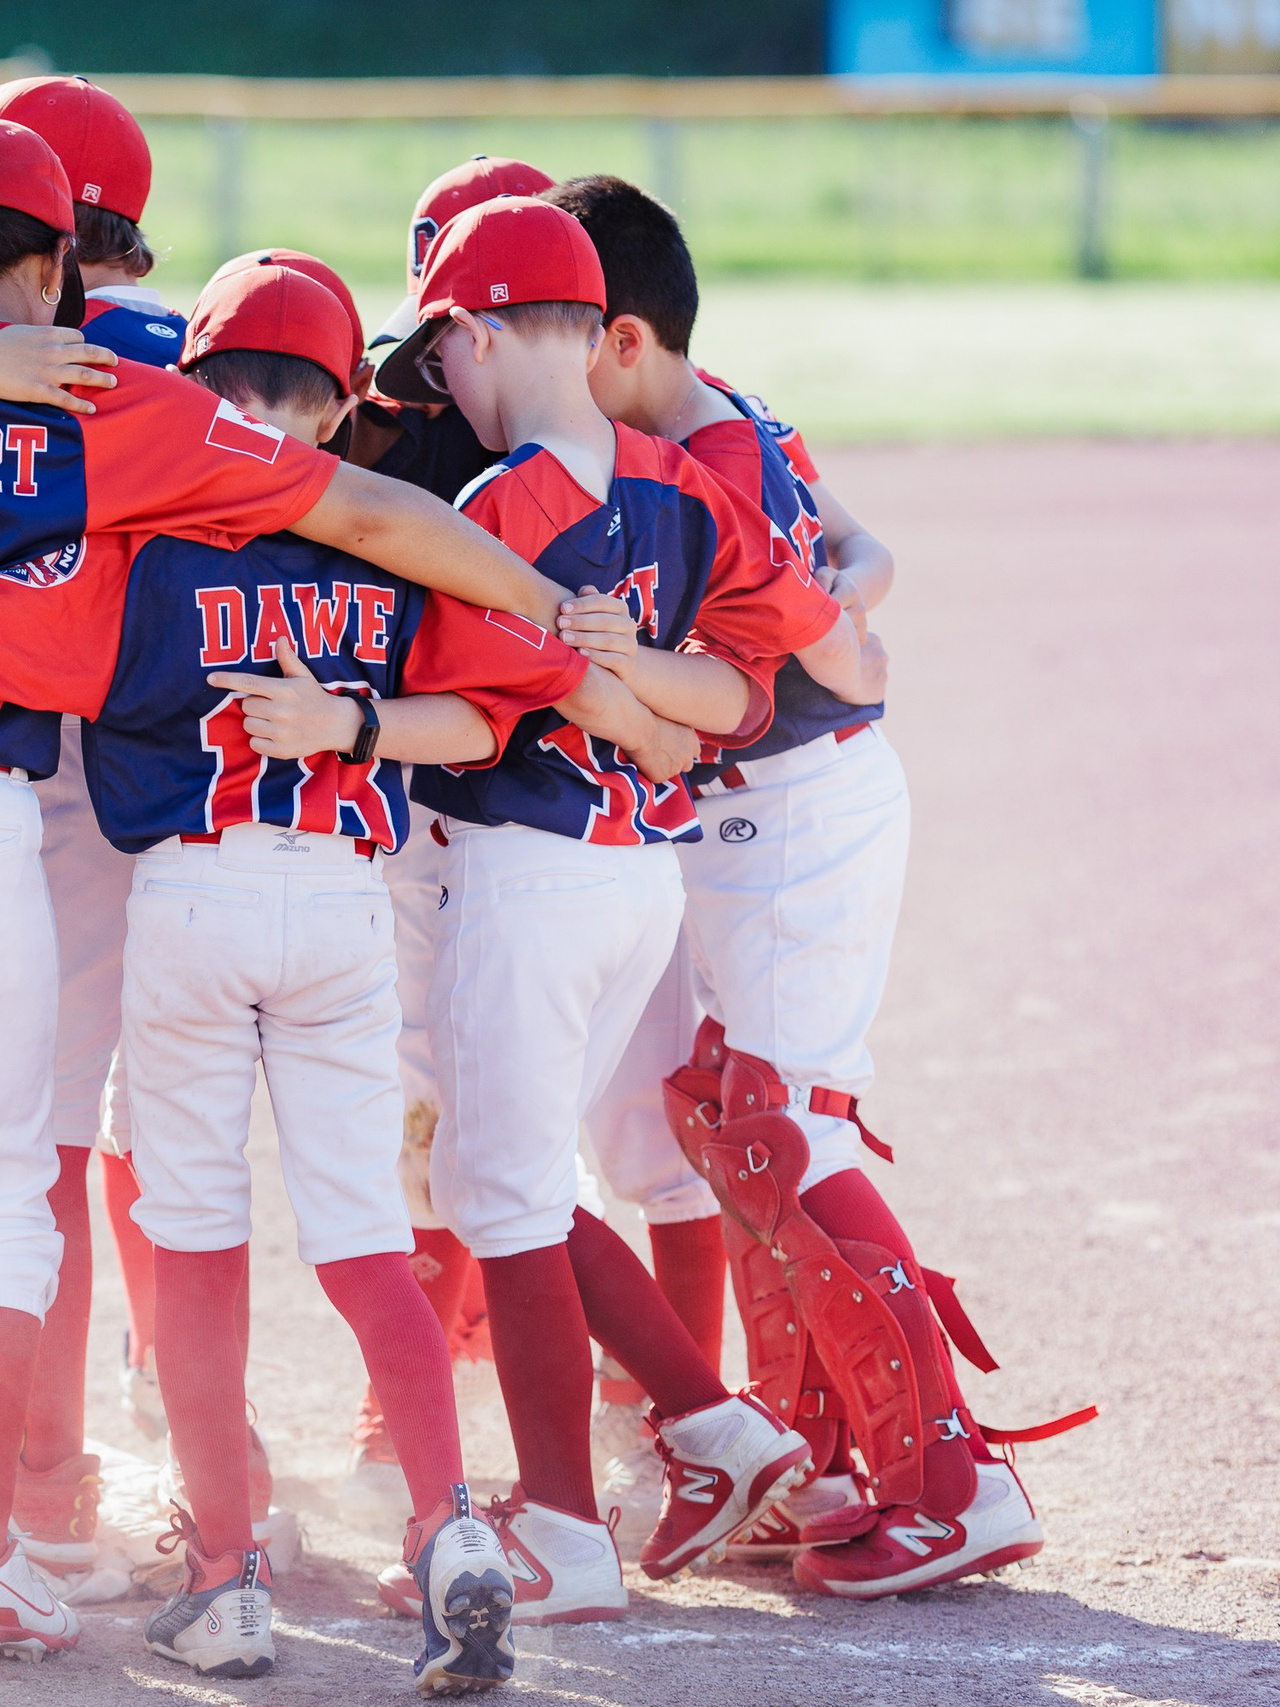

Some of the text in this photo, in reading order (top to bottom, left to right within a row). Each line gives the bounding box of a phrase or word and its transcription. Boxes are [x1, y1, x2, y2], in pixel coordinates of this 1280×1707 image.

[194, 580, 396, 668] DAWE
[676, 1468, 719, 1505] N
[886, 1512, 955, 1557] N
